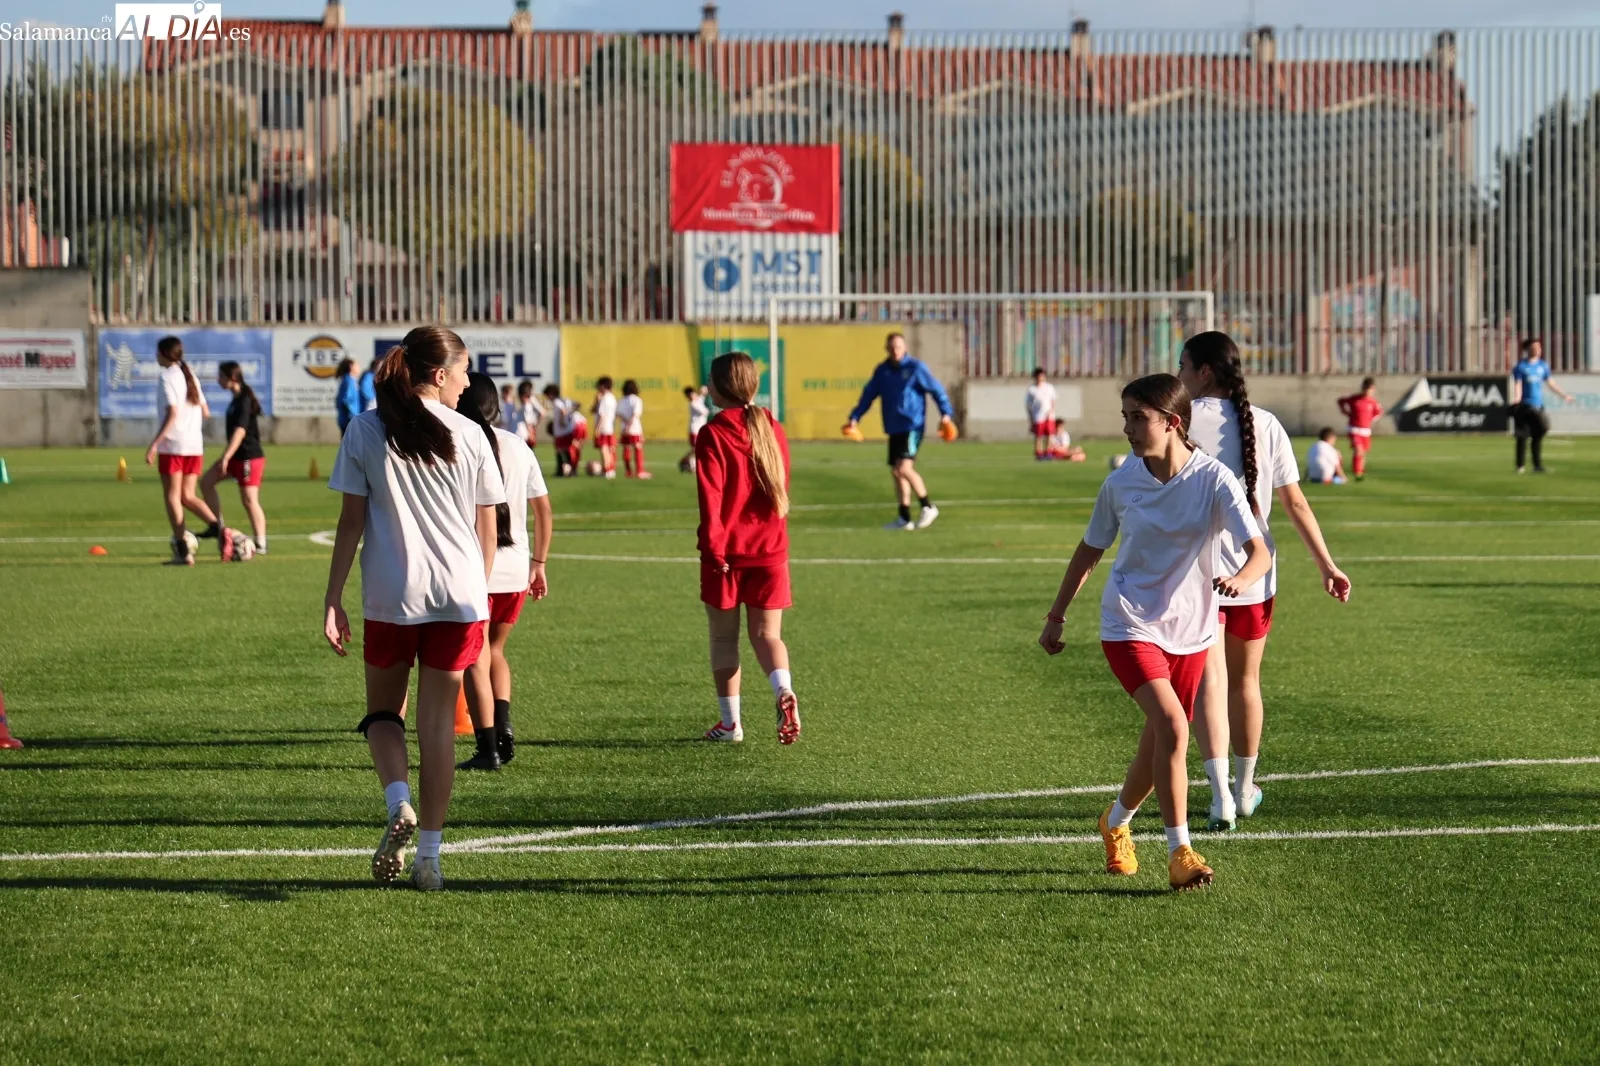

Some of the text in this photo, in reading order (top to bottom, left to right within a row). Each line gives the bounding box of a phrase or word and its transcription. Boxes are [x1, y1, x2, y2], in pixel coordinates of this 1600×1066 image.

[752, 249, 822, 275] MST
[25, 351, 77, 373] Miguel
[468, 353, 541, 377] EL
